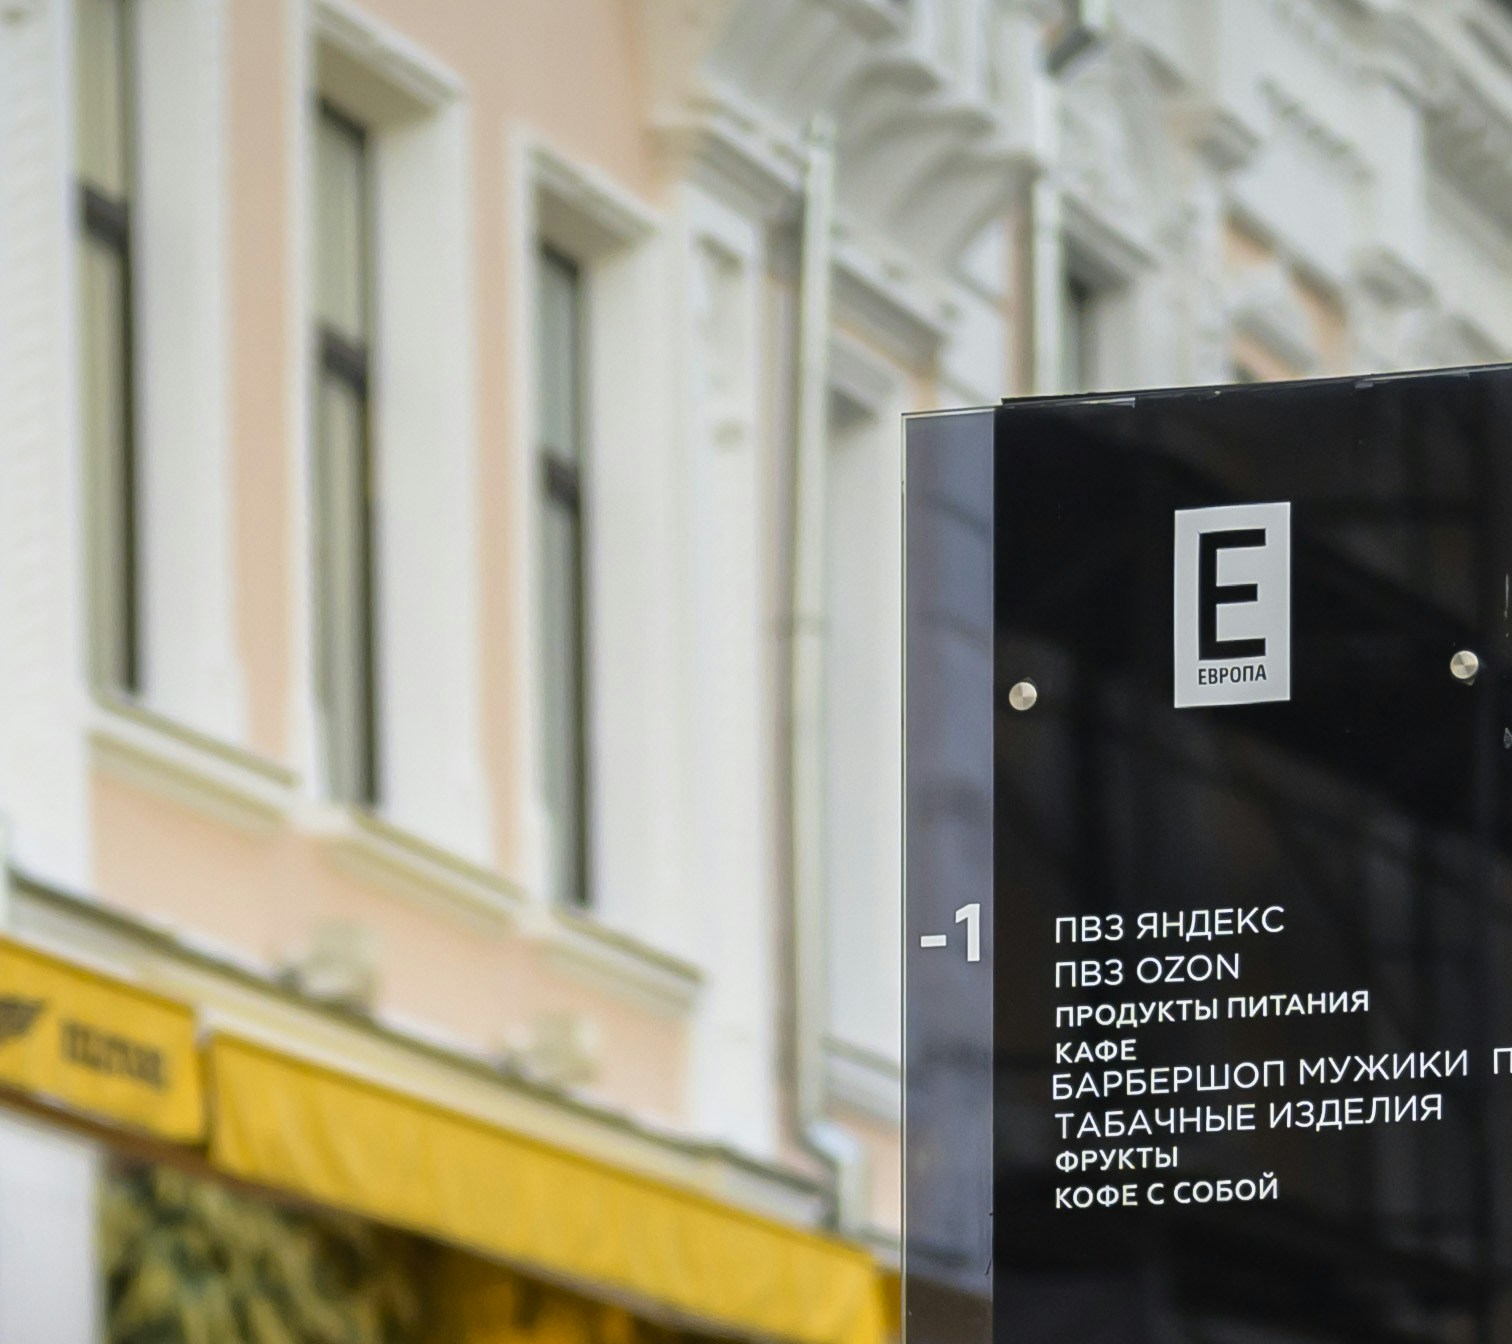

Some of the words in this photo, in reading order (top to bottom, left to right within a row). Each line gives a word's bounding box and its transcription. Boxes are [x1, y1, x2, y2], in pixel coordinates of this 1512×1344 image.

[1198, 664, 1267, 685] ЕВРОПА
[920, 903, 980, 962] -1
[1056, 914, 1123, 943] ПВЗ
[1137, 906, 1284, 942] ЯНДЕКС
[1056, 959, 1123, 988] ПВЗ
[1137, 953, 1240, 983] OZON
[1056, 998, 1217, 1028] ПРОДУКТЫ
[1228, 990, 1369, 1018] ПИТАНИЯ
[1056, 1039, 1137, 1064] КАФЕ
[1053, 1060, 1284, 1100] БАРБЕРШОП
[1300, 1050, 1467, 1085] МУЖИКИ
[1055, 1104, 1255, 1139] ТАБАЧНЫЕ
[1270, 1094, 1442, 1132] ИЗДЕЛИЯ
[1056, 1146, 1178, 1172] ФРУКТЫ
[1056, 1184, 1137, 1208] КОФЕ
[1147, 1183, 1164, 1204] С
[1174, 1171, 1278, 1203] СОБОЙ
